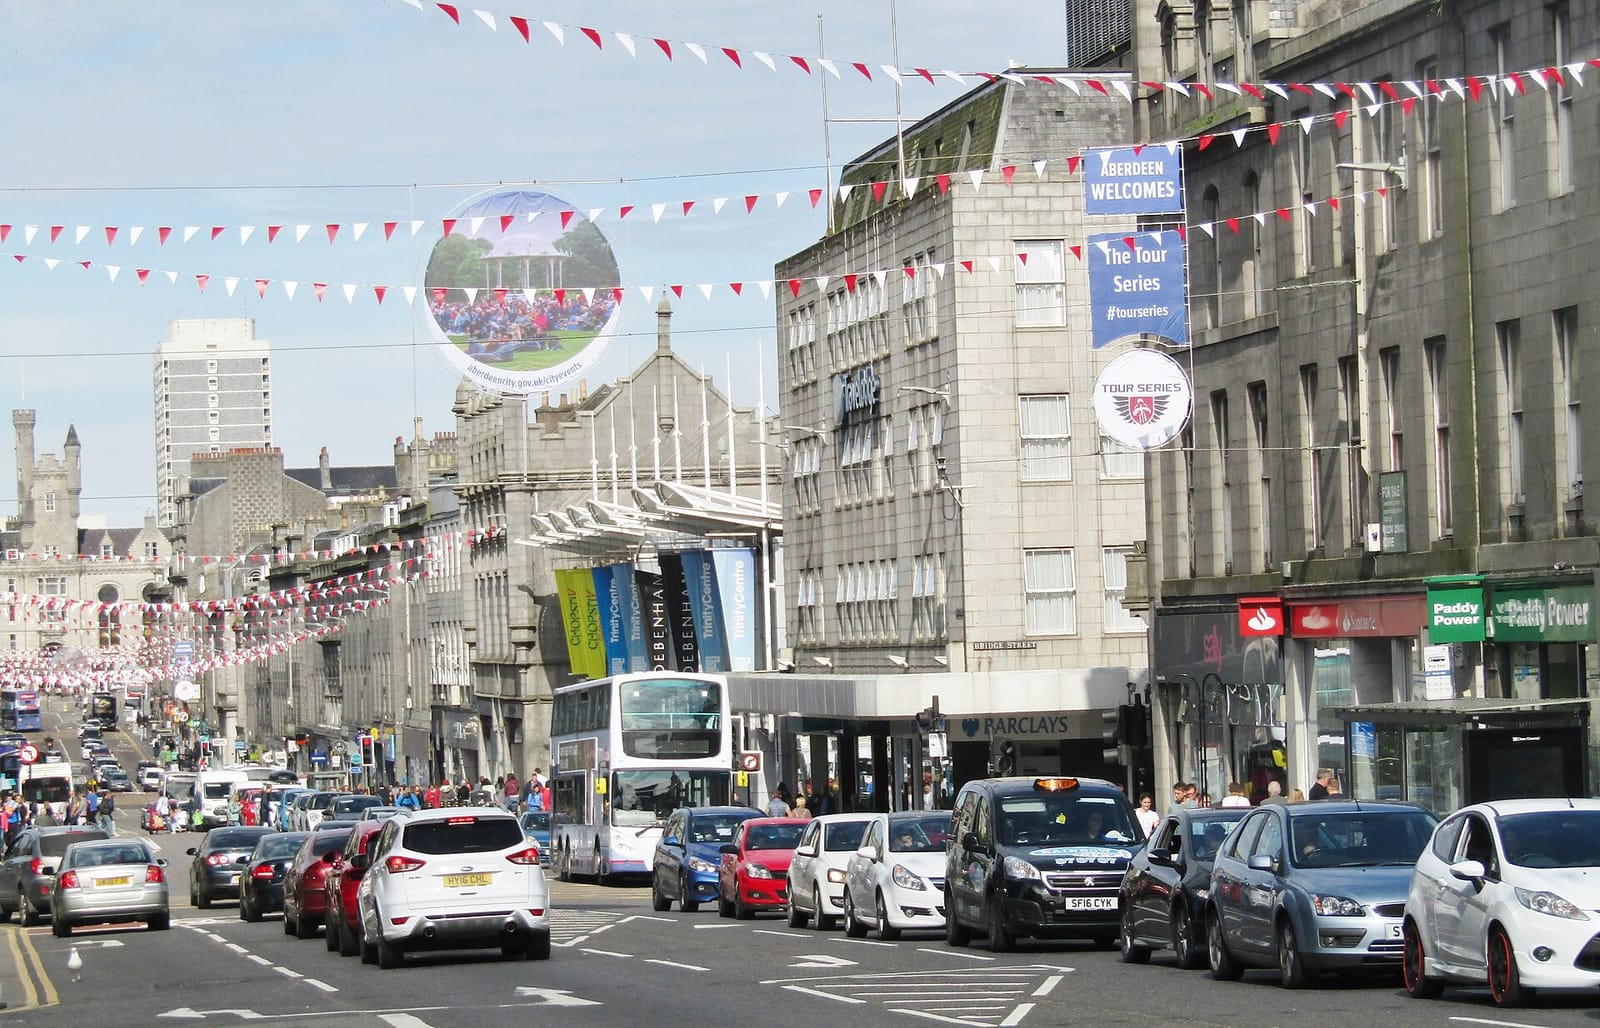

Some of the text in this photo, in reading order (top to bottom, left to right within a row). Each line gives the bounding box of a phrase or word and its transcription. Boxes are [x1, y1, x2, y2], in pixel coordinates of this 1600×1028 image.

[1101, 160, 1163, 176] ABERDEEN
[1091, 181, 1175, 200] WELCOMES
[1105, 246, 1168, 265] The Tour
[1113, 275, 1160, 292] Series
[1107, 304, 1169, 320] #tourseries
[467, 360, 583, 389] aberdeencity.gov.uk/cityevents
[1102, 383, 1182, 393] TOUR SERIES
[701, 562, 714, 638] TrinityCentre
[734, 560, 746, 638] TrinityCentre
[1433, 602, 1479, 615] Paddy
[1547, 596, 1589, 627] Power
[1434, 615, 1480, 626] Power
[974, 641, 1037, 650] BRIDGE STREET
[984, 716, 1068, 734] BARCLAYS
[1072, 899, 1112, 908] SF16 CYK
